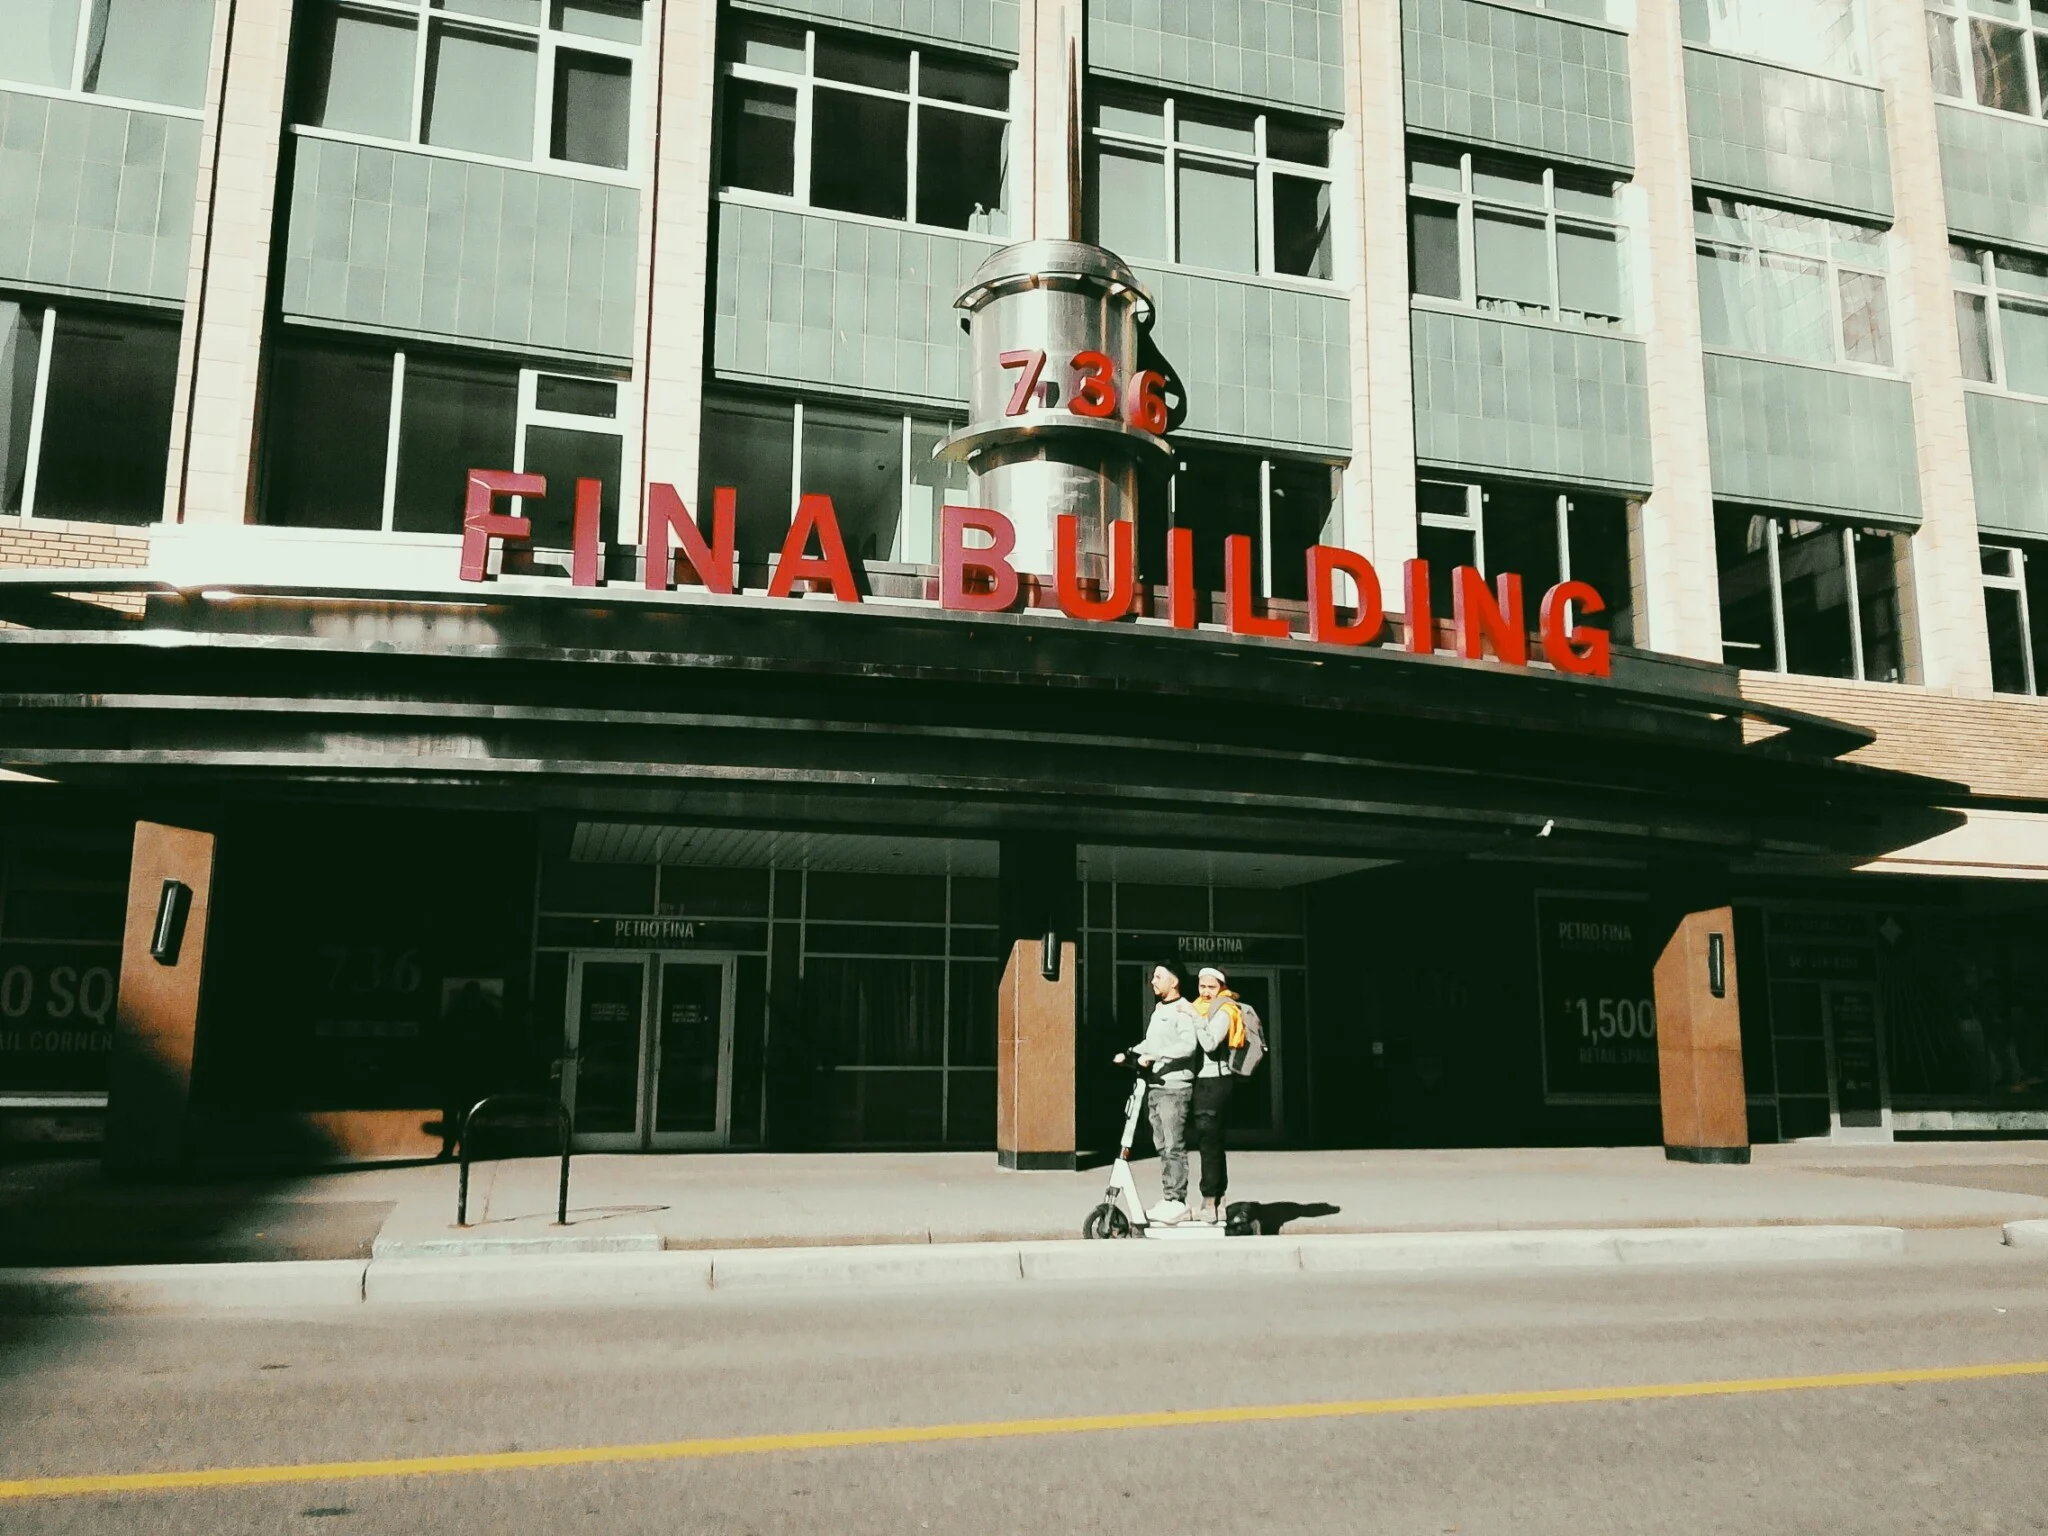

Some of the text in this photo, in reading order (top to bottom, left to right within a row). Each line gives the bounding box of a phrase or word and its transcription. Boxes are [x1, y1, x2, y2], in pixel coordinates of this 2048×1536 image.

[998, 347, 1170, 436] 736
[458, 469, 1612, 678] FINA BUILDING
[45, 965, 115, 1026] SQ
[29, 1030, 114, 1053] CORNER
[1578, 1046, 1616, 1065] RETAIL
